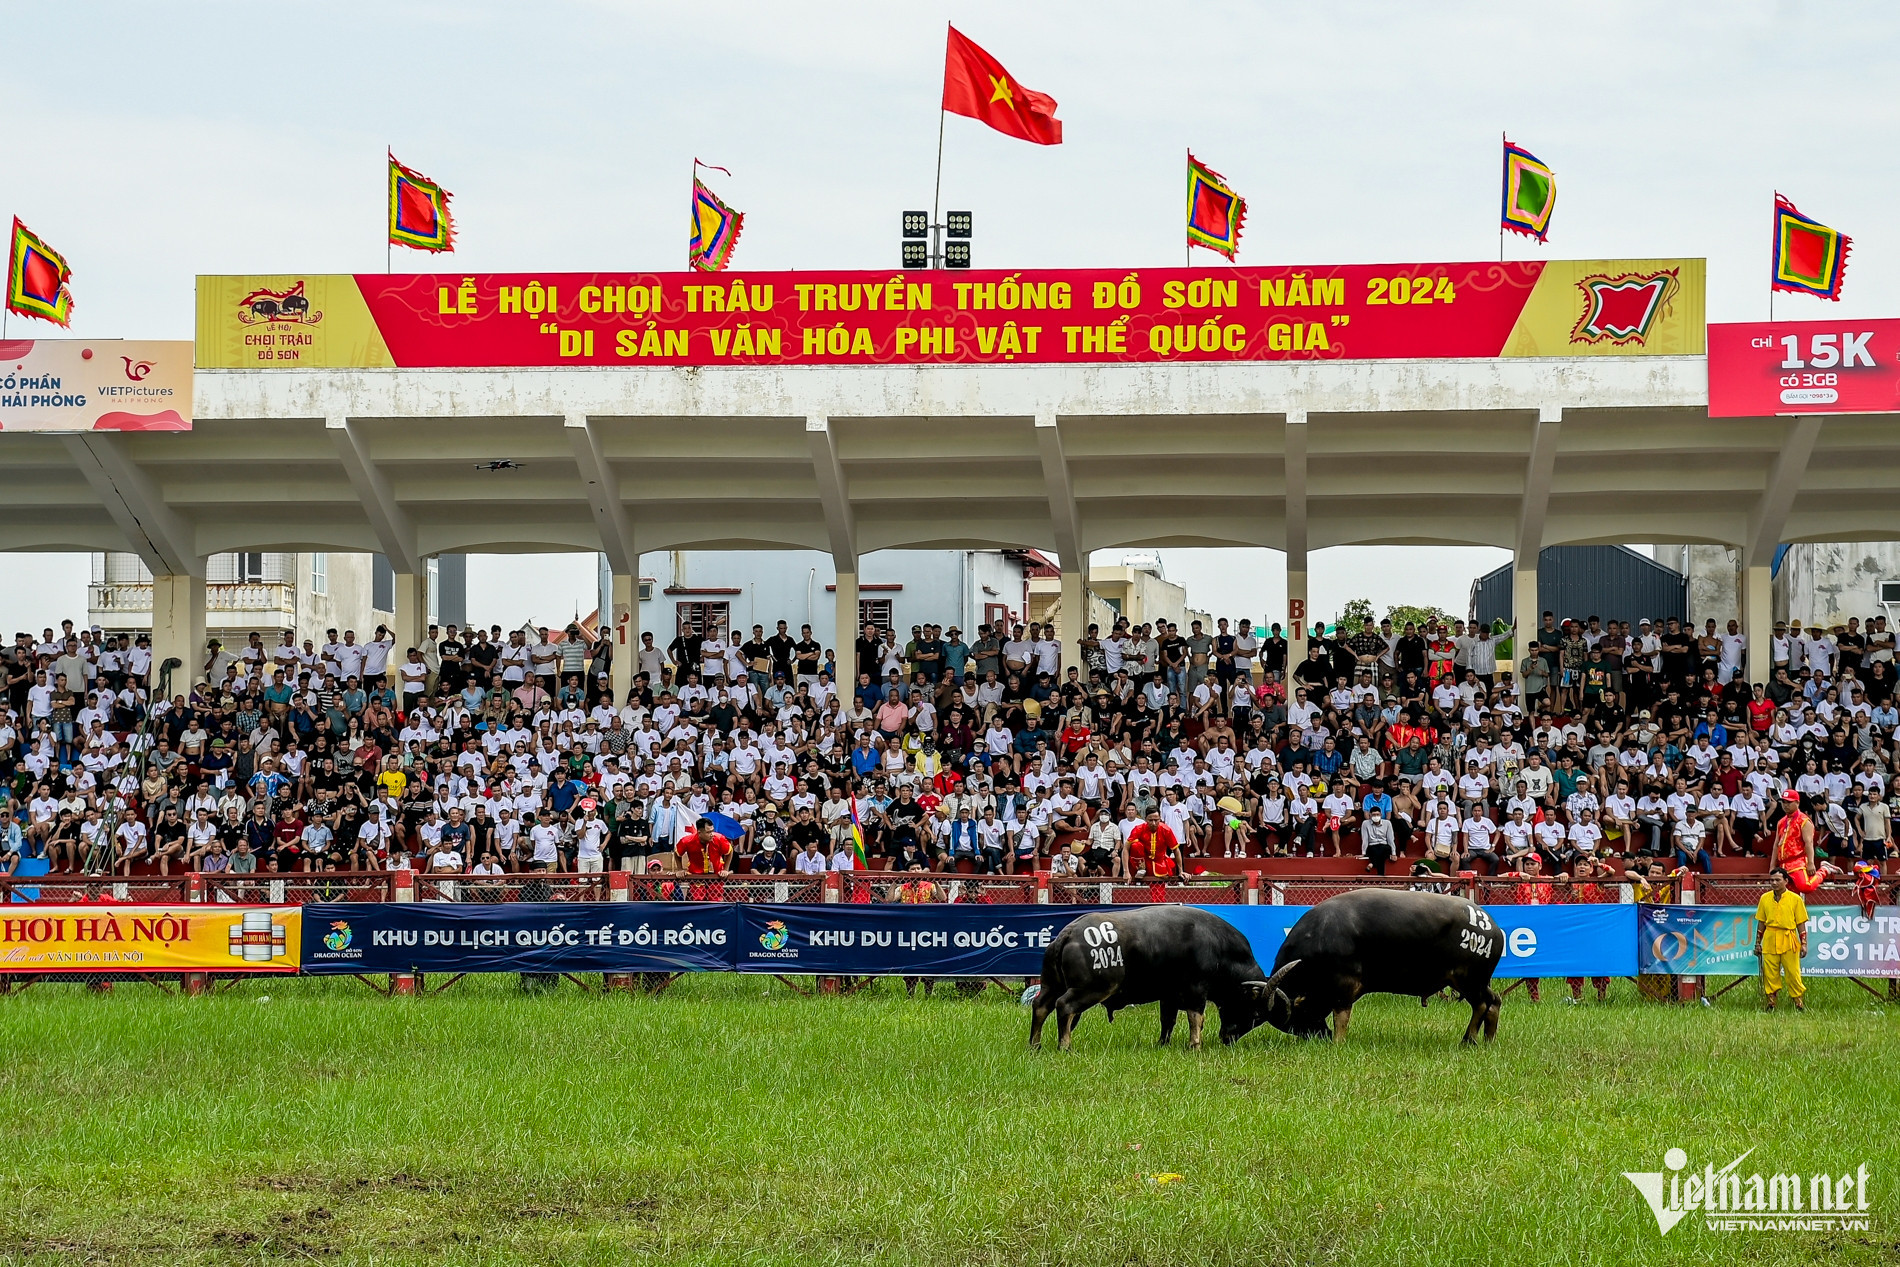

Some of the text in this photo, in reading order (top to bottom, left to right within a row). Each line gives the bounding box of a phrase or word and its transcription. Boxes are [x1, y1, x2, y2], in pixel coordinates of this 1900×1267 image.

[439, 272, 1456, 319] LỄ HỘI CHỌI TRÂU TRUYỀN THỐNG ĐỒ SƠN NĂM 2024
[245, 331, 312, 348] CHỌI TRÂU
[540, 315, 1350, 360] “DI SẢN VĂN HÓA PHI VẬT THỂ QUỐC GIA”
[1751, 332, 1877, 369] CHỈ 15K
[20, 373, 61, 390] PHẦN
[98, 386, 173, 396] VIETPictures
[1802, 373, 1838, 387] 3GB
[2, 391, 87, 407] HẢI PHÒNG
[3, 911, 191, 949] HƠI HÀ NỘI
[1467, 905, 1492, 931] 13
[1805, 911, 1871, 934] HÒNG
[373, 922, 727, 951] KHU DU LỊCH QUỐC TẾ ĐỒI RỒNG
[809, 924, 1054, 952] KHU DU LỊCH QUỐC TẾ
[1083, 921, 1119, 948] 06
[1460, 928, 1493, 959] 2024
[48, 950, 144, 963] VĂN HÓA HÀ NỘI
[1090, 946, 1124, 970] 2024
[1706, 950, 1753, 965] CONVENTION
[1817, 936, 1850, 961] SỐ
[1854, 943, 1864, 961] 1
